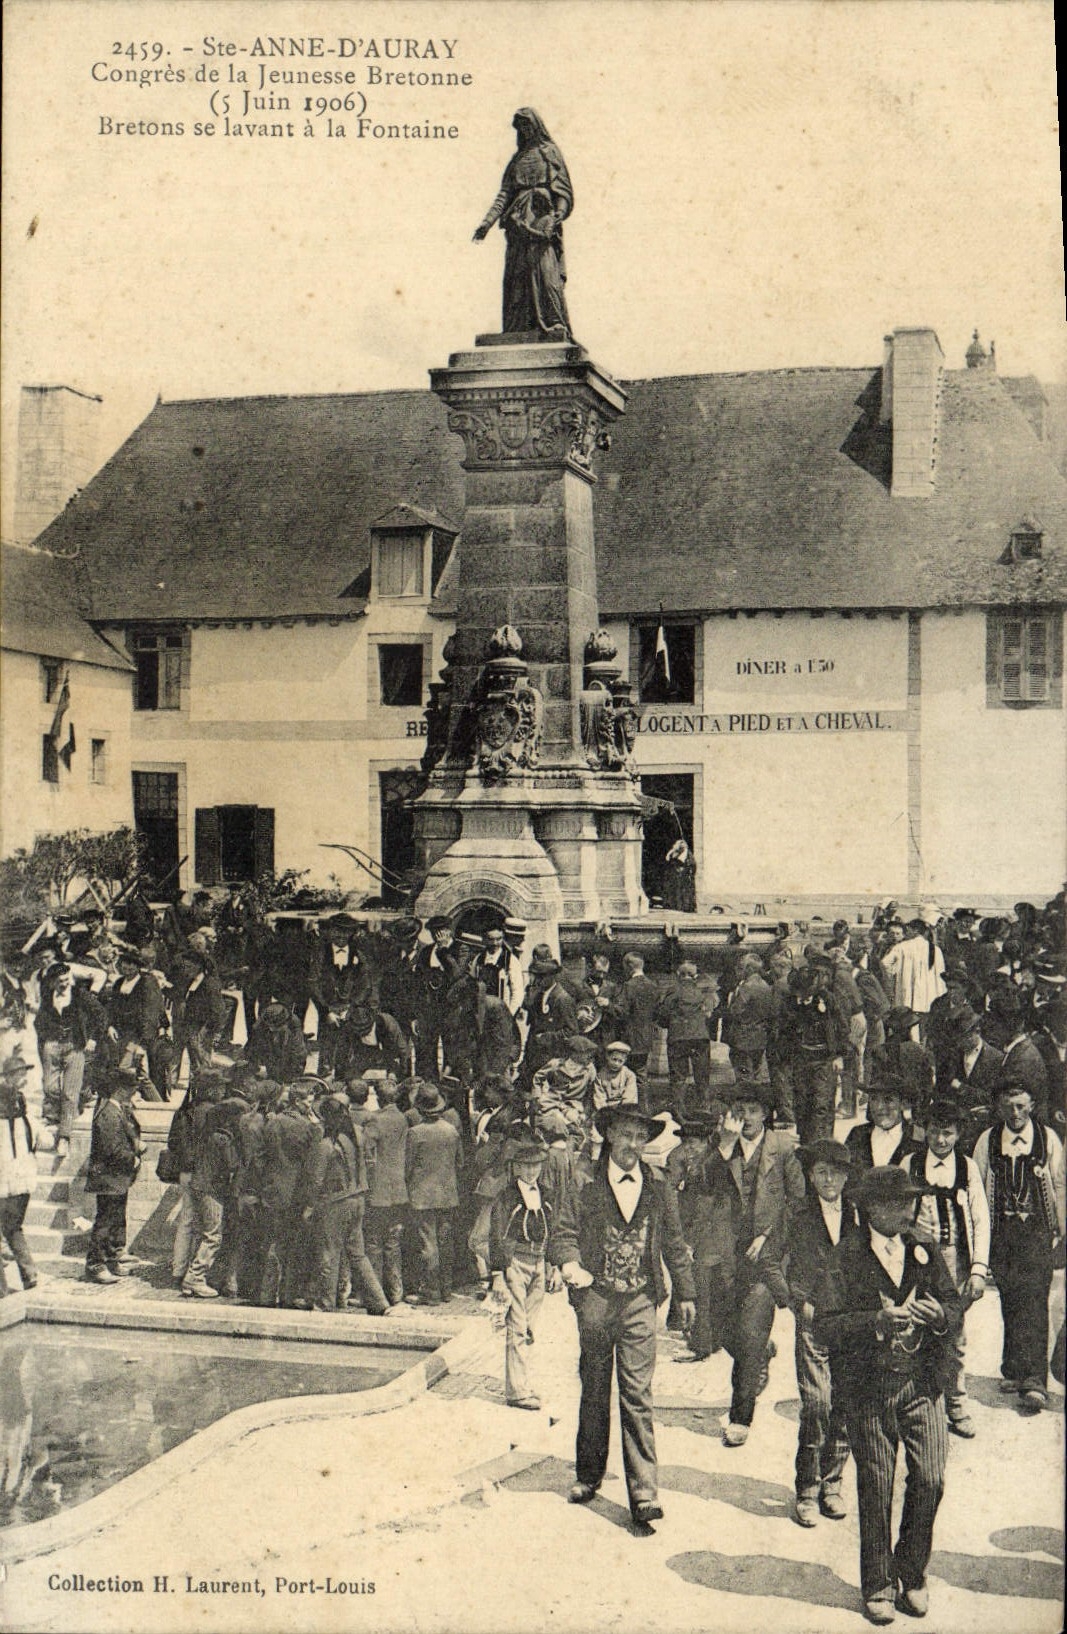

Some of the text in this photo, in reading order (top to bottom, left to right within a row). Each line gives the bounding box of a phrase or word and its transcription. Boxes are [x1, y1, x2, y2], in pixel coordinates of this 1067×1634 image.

[636, 715, 709, 733] LOGENT
[711, 719, 721, 732] A
[729, 714, 770, 732] PIED
[776, 717, 793, 731] ET
[799, 717, 809, 730] A
[815, 712, 892, 730] CHEVAL.
